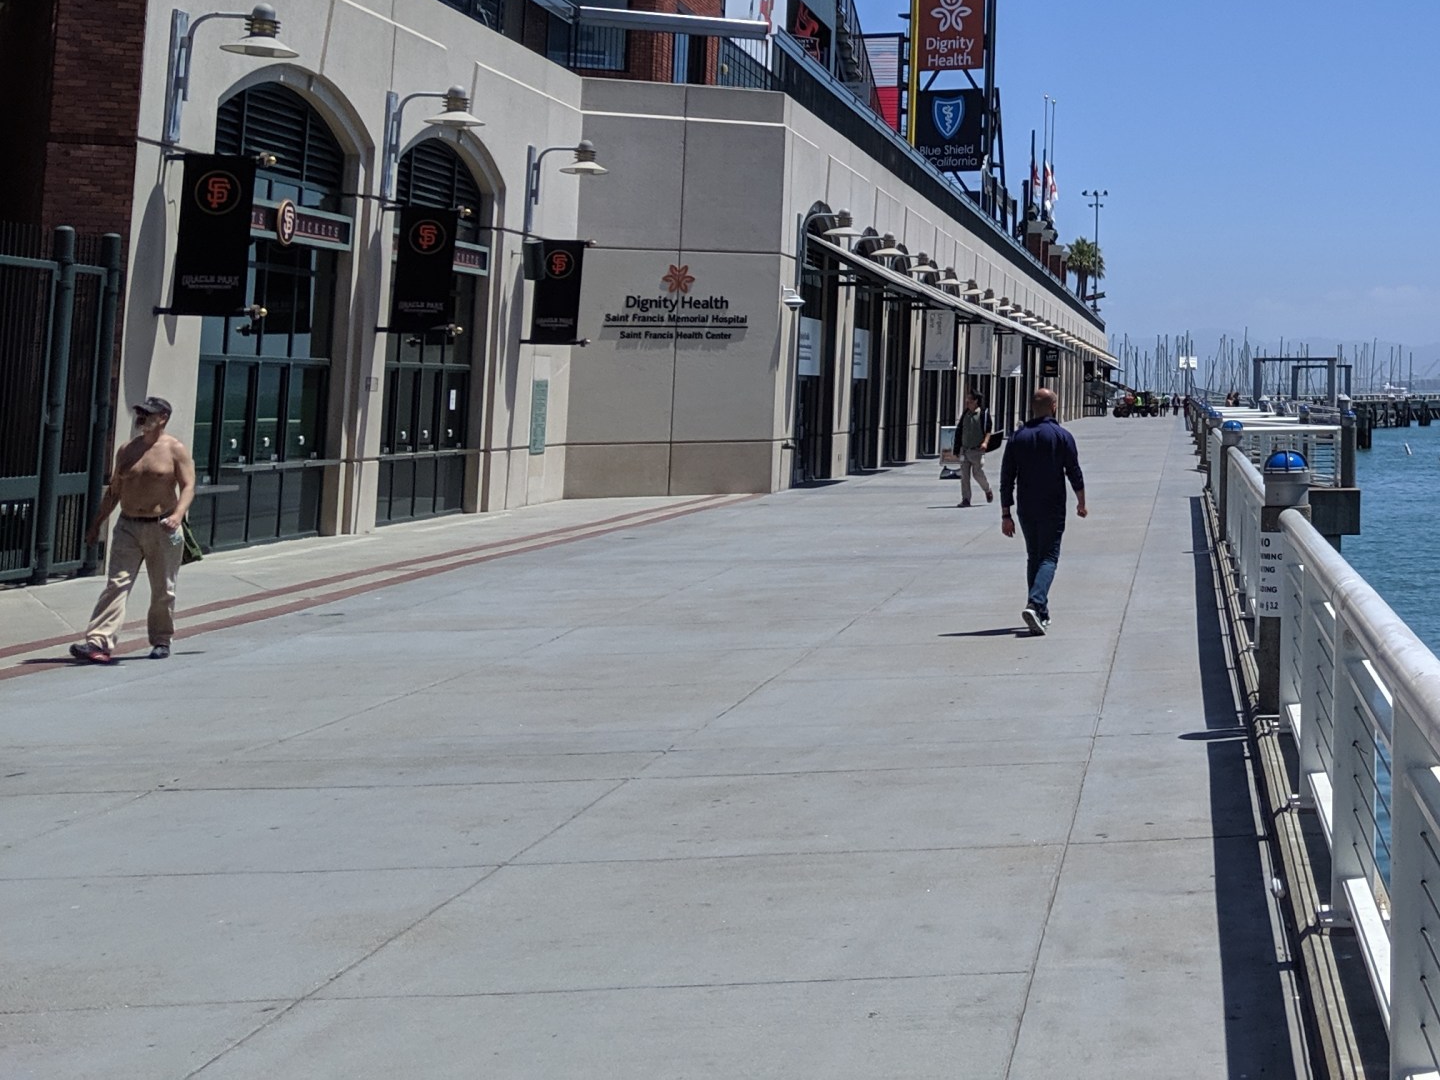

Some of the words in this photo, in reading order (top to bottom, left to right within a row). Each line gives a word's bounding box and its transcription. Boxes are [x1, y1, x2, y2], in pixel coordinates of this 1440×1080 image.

[926, 37, 974, 54] Dignity
[928, 52, 972, 67] Health
[919, 145, 941, 156] Blue
[944, 144, 975, 156] Shield
[930, 156, 978, 167] California
[295, 217, 340, 238] TICKETS
[455, 251, 480, 265] CKETS
[625, 295, 678, 312] Dignity
[681, 295, 729, 310] Health
[604, 313, 629, 322] Saint
[632, 313, 664, 323] Francis
[667, 314, 709, 323] Memorial
[711, 314, 748, 325] Hospital
[619, 331, 641, 339] Saint
[644, 331, 674, 339] Francis
[676, 331, 703, 339] Health
[705, 331, 732, 340] Center
